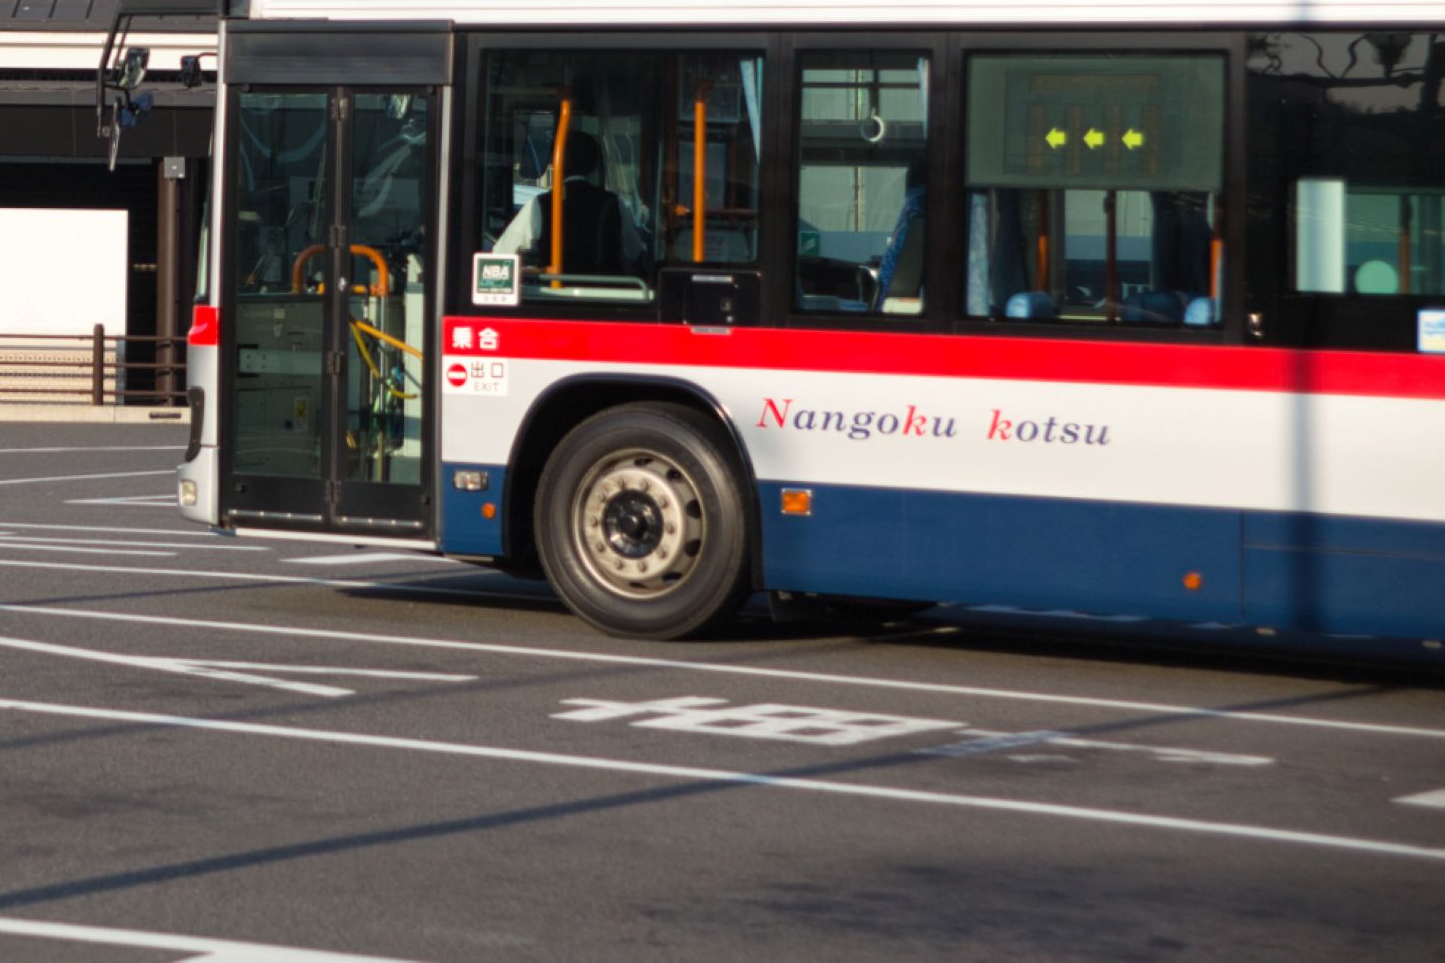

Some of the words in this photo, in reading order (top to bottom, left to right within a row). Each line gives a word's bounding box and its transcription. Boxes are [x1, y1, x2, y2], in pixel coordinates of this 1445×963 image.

[452, 327, 499, 350] 乗合
[470, 361, 504, 378] 出口
[474, 382, 500, 392] EXIT
[756, 398, 958, 440] Nangoku
[986, 408, 1112, 446] kotsu
